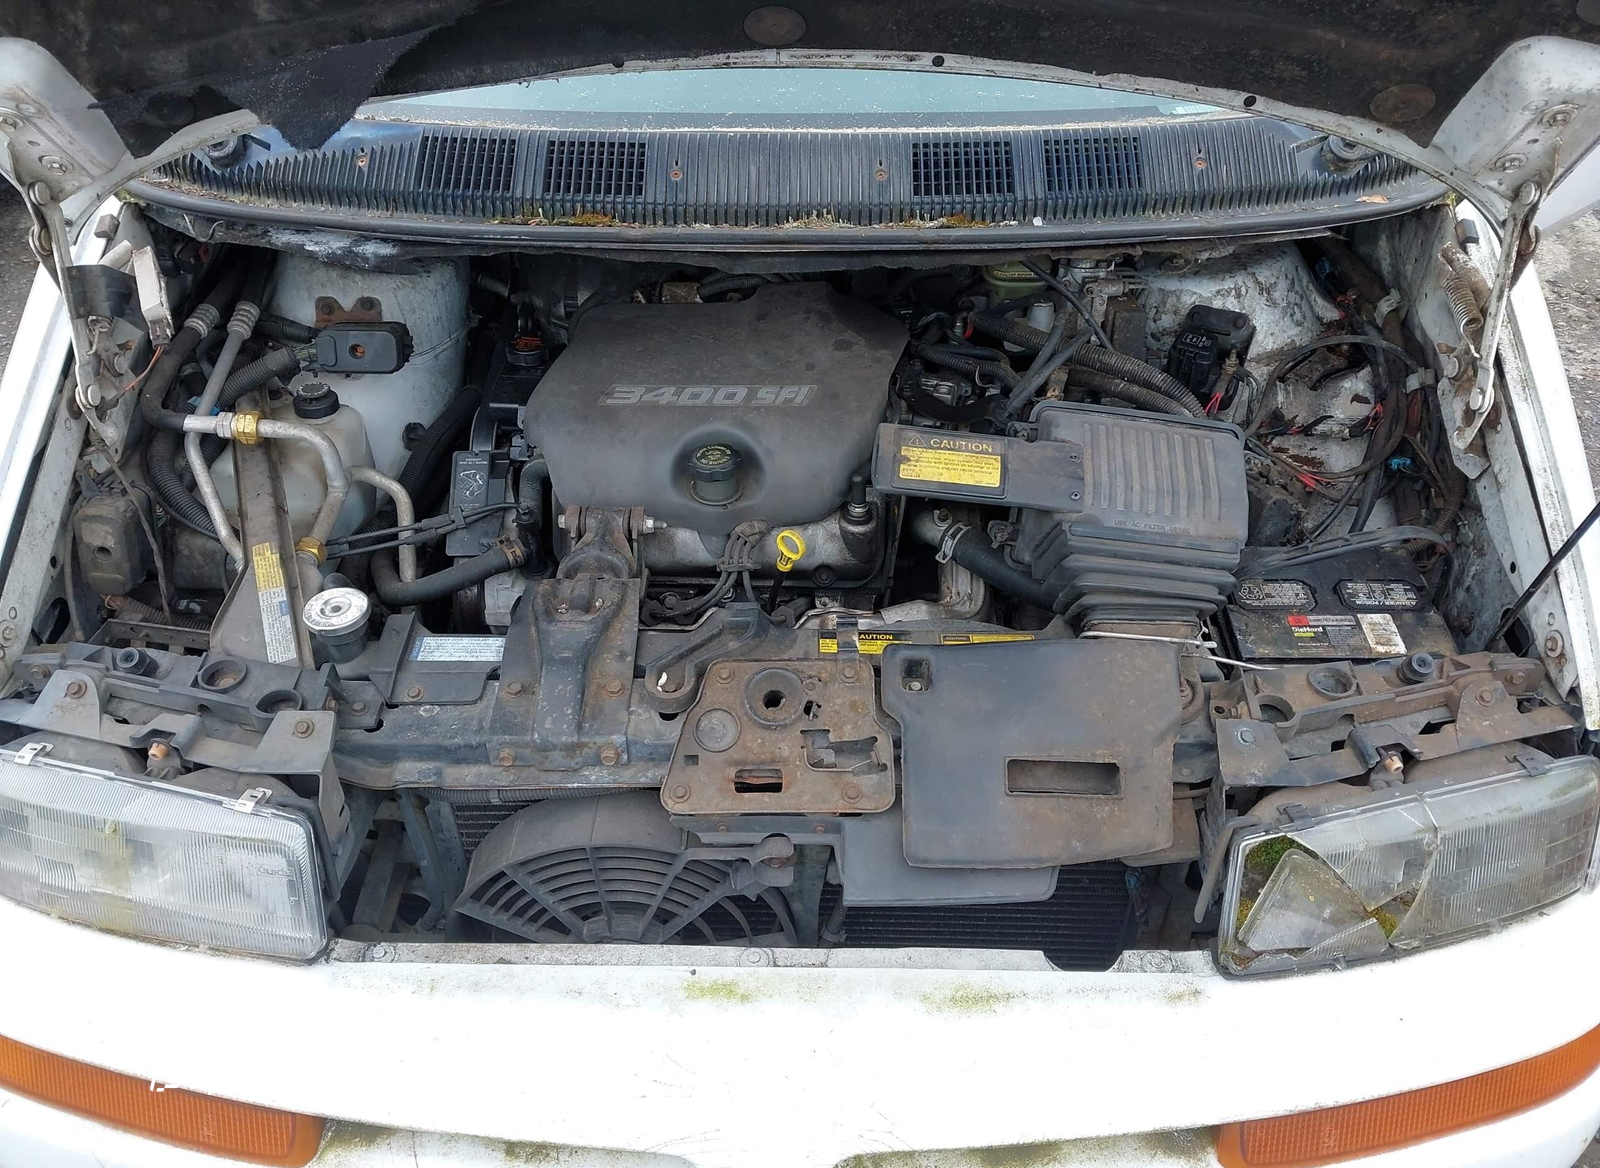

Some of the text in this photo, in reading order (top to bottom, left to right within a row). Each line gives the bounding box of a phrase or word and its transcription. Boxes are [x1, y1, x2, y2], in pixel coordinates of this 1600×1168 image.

[606, 387, 810, 405] 3400 SFI
[930, 438, 992, 453] CAUTION
[1114, 519, 1128, 527] USE
[1144, 523, 1166, 531] FILTER
